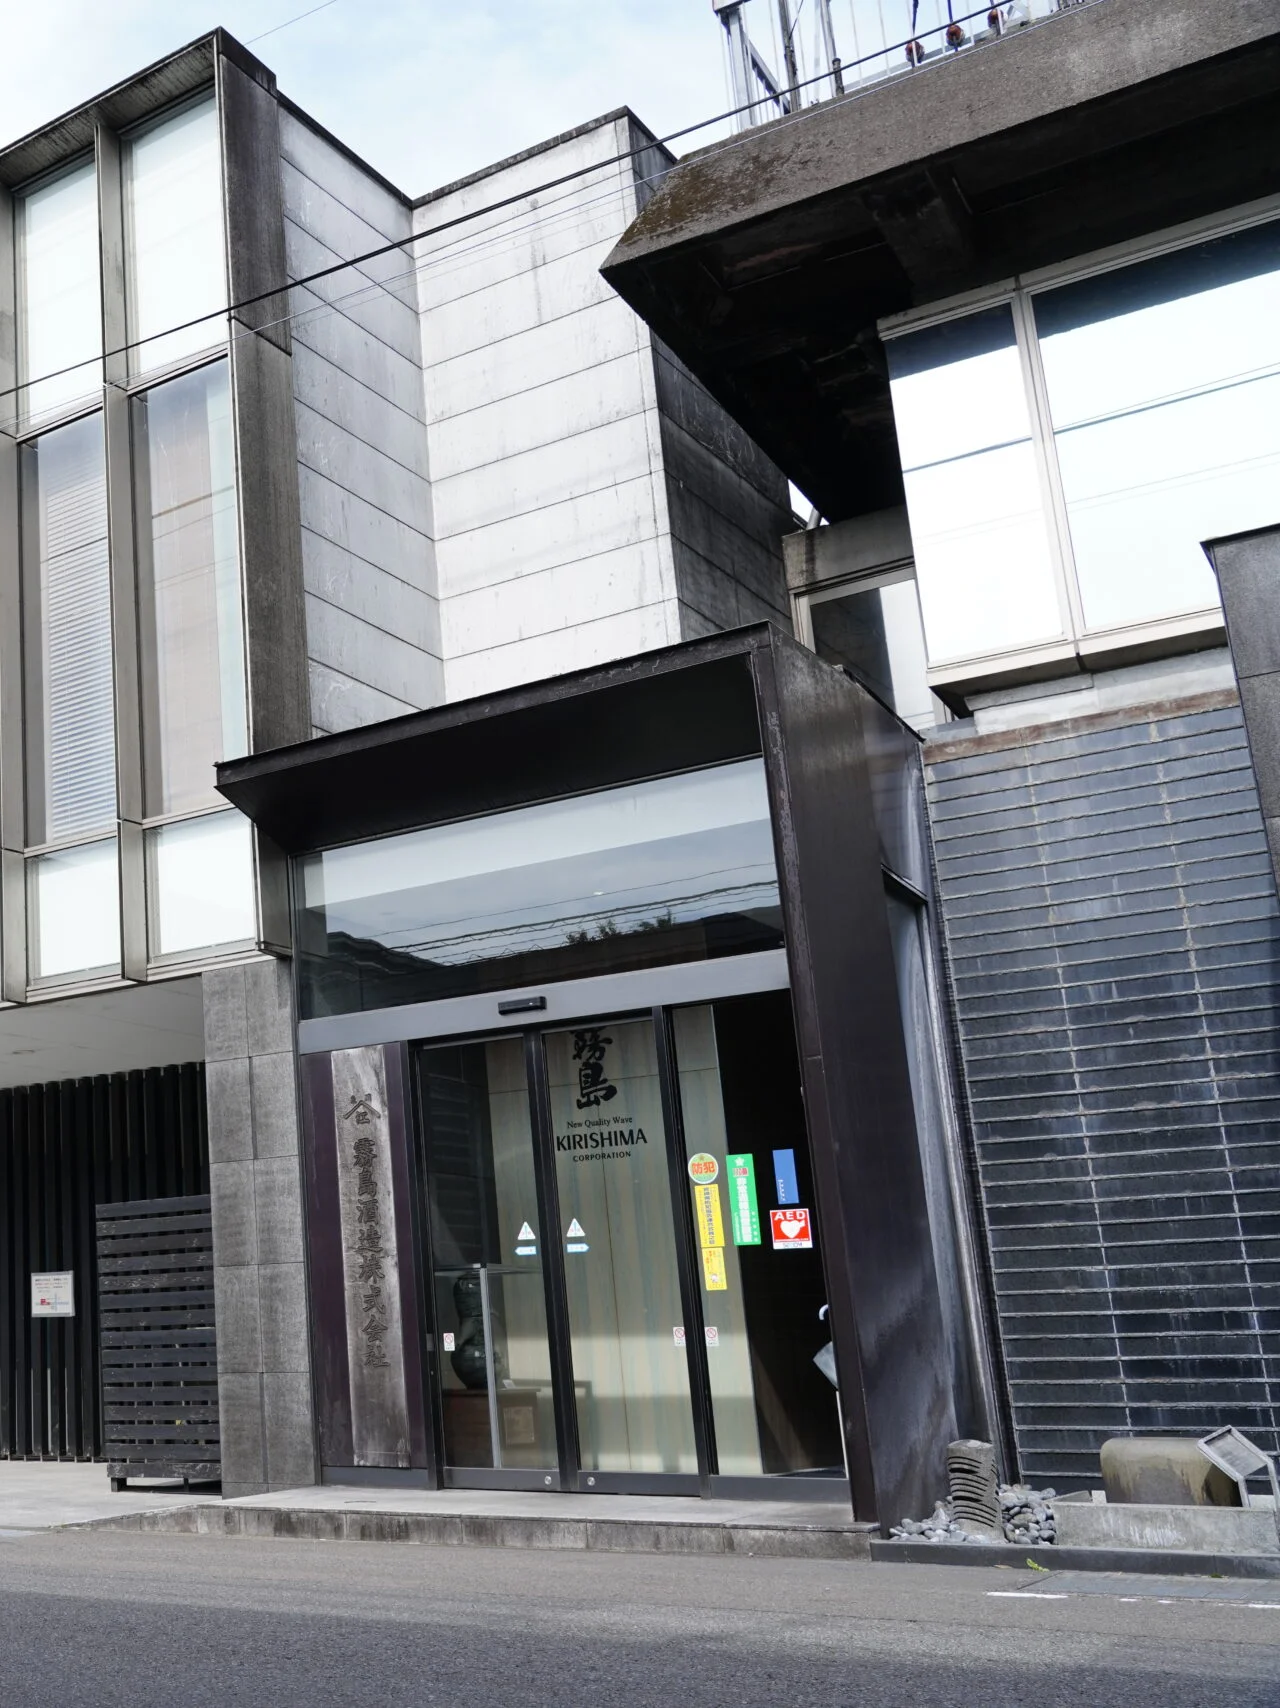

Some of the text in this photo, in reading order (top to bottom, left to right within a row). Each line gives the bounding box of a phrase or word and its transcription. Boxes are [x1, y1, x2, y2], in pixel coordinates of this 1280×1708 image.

[567, 1116, 633, 1129] New Quality Wave
[556, 1128, 648, 1152] KIRISHIMA
[572, 1151, 632, 1162] CORPORATION
[692, 1161, 716, 1175] 防犯
[774, 1211, 806, 1220] AED
[353, 1138, 390, 1367] 霧島酒造株式会社
